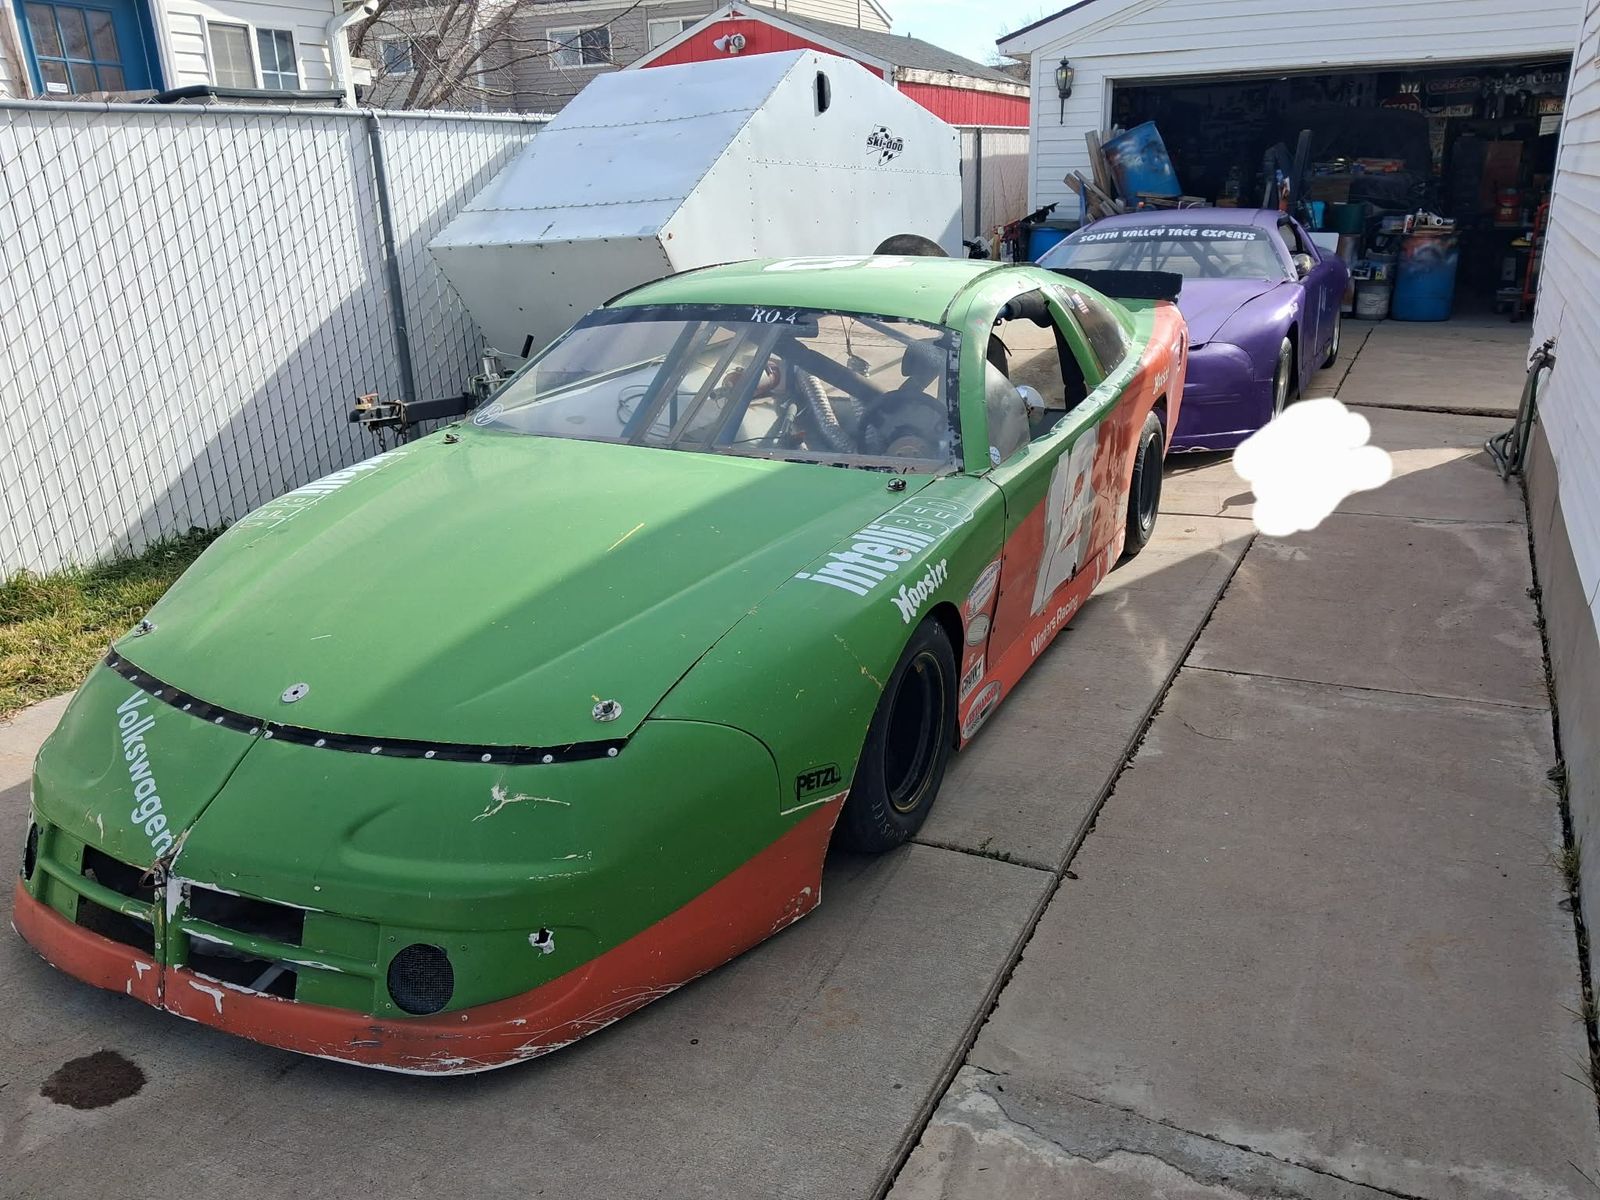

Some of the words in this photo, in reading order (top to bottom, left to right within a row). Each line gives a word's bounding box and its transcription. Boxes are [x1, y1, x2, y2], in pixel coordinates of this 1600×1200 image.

[1079, 231, 1119, 243] SOUTH
[1122, 228, 1166, 238] VALLEY
[1168, 228, 1198, 237] TREE
[1201, 228, 1257, 241] EXPERTS
[890, 558, 948, 624] Hoosier
[1056, 594, 1080, 625] Racing
[116, 688, 173, 857] Volkswagen
[796, 765, 842, 801] PETZL
